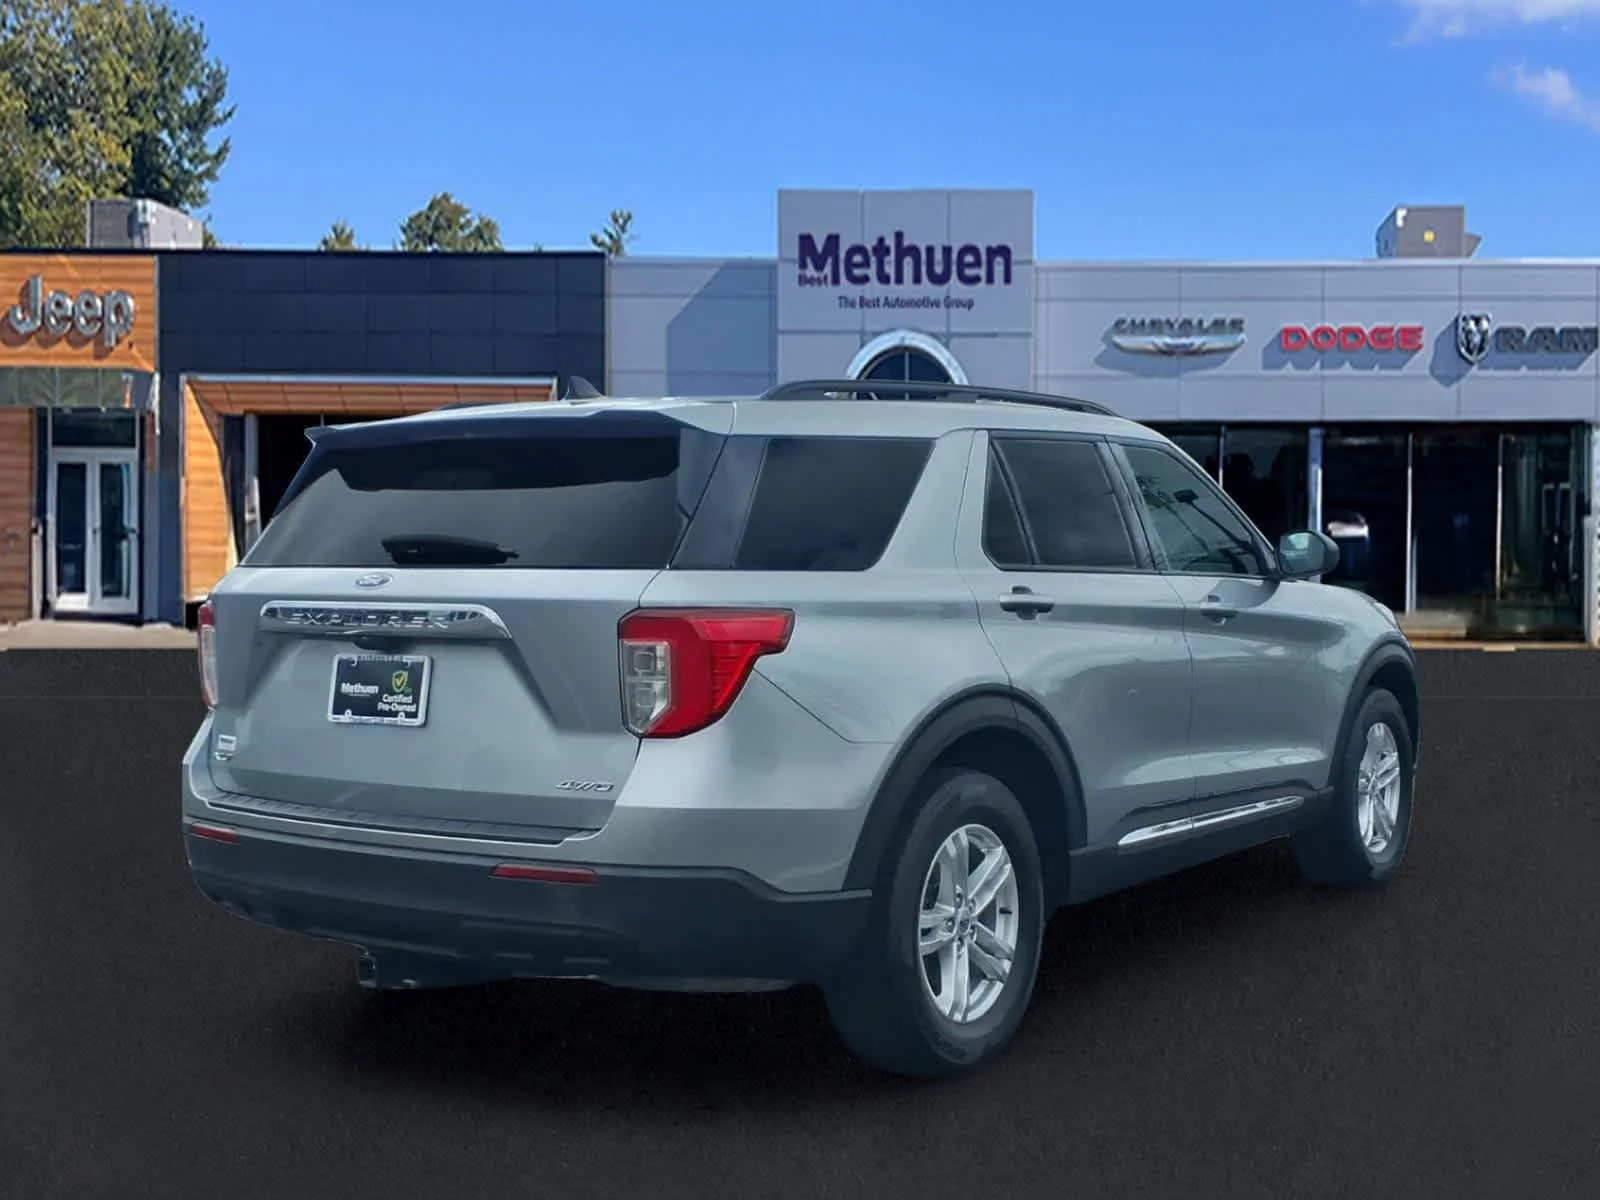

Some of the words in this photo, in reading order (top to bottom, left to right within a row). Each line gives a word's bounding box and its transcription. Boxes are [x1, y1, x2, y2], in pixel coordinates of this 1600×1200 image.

[798, 230, 1013, 286] Methuen
[9, 275, 135, 347] Jeep
[838, 296, 857, 309] The
[859, 296, 880, 309] Best
[882, 296, 941, 309] Automotive
[943, 296, 975, 311] Group
[1281, 325, 1424, 352] DODGE
[1495, 326, 1599, 353] RAM
[377, 702, 417, 712] Pre-Owned
[382, 693, 413, 704] Certified
